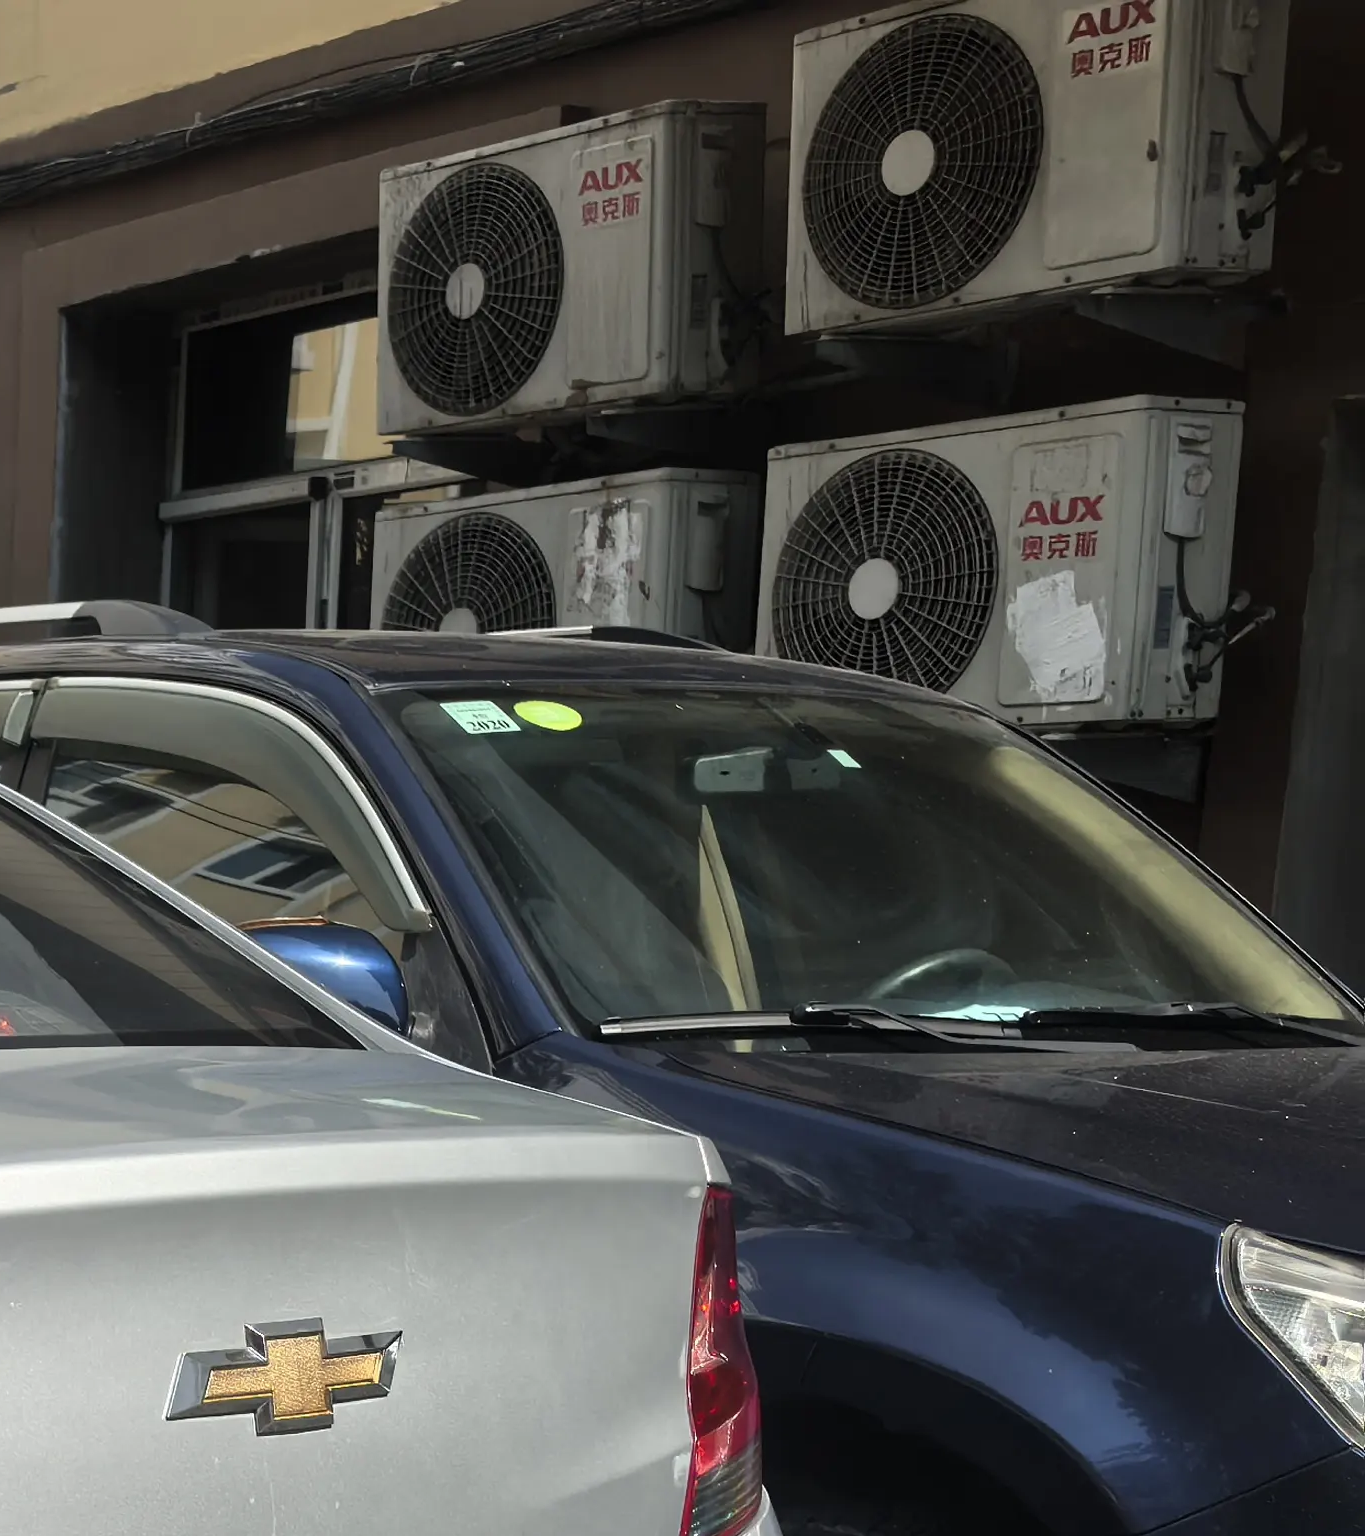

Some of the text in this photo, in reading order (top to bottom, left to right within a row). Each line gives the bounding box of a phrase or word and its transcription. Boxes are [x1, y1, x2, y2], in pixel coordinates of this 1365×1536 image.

[1066, 0, 1155, 44] AUX
[1071, 34, 1151, 78] 奥克斯
[578, 158, 644, 196] AUX
[581, 191, 640, 226] 奥克斯
[1018, 494, 1105, 528] AUX
[1021, 530, 1098, 561] 奥克斯
